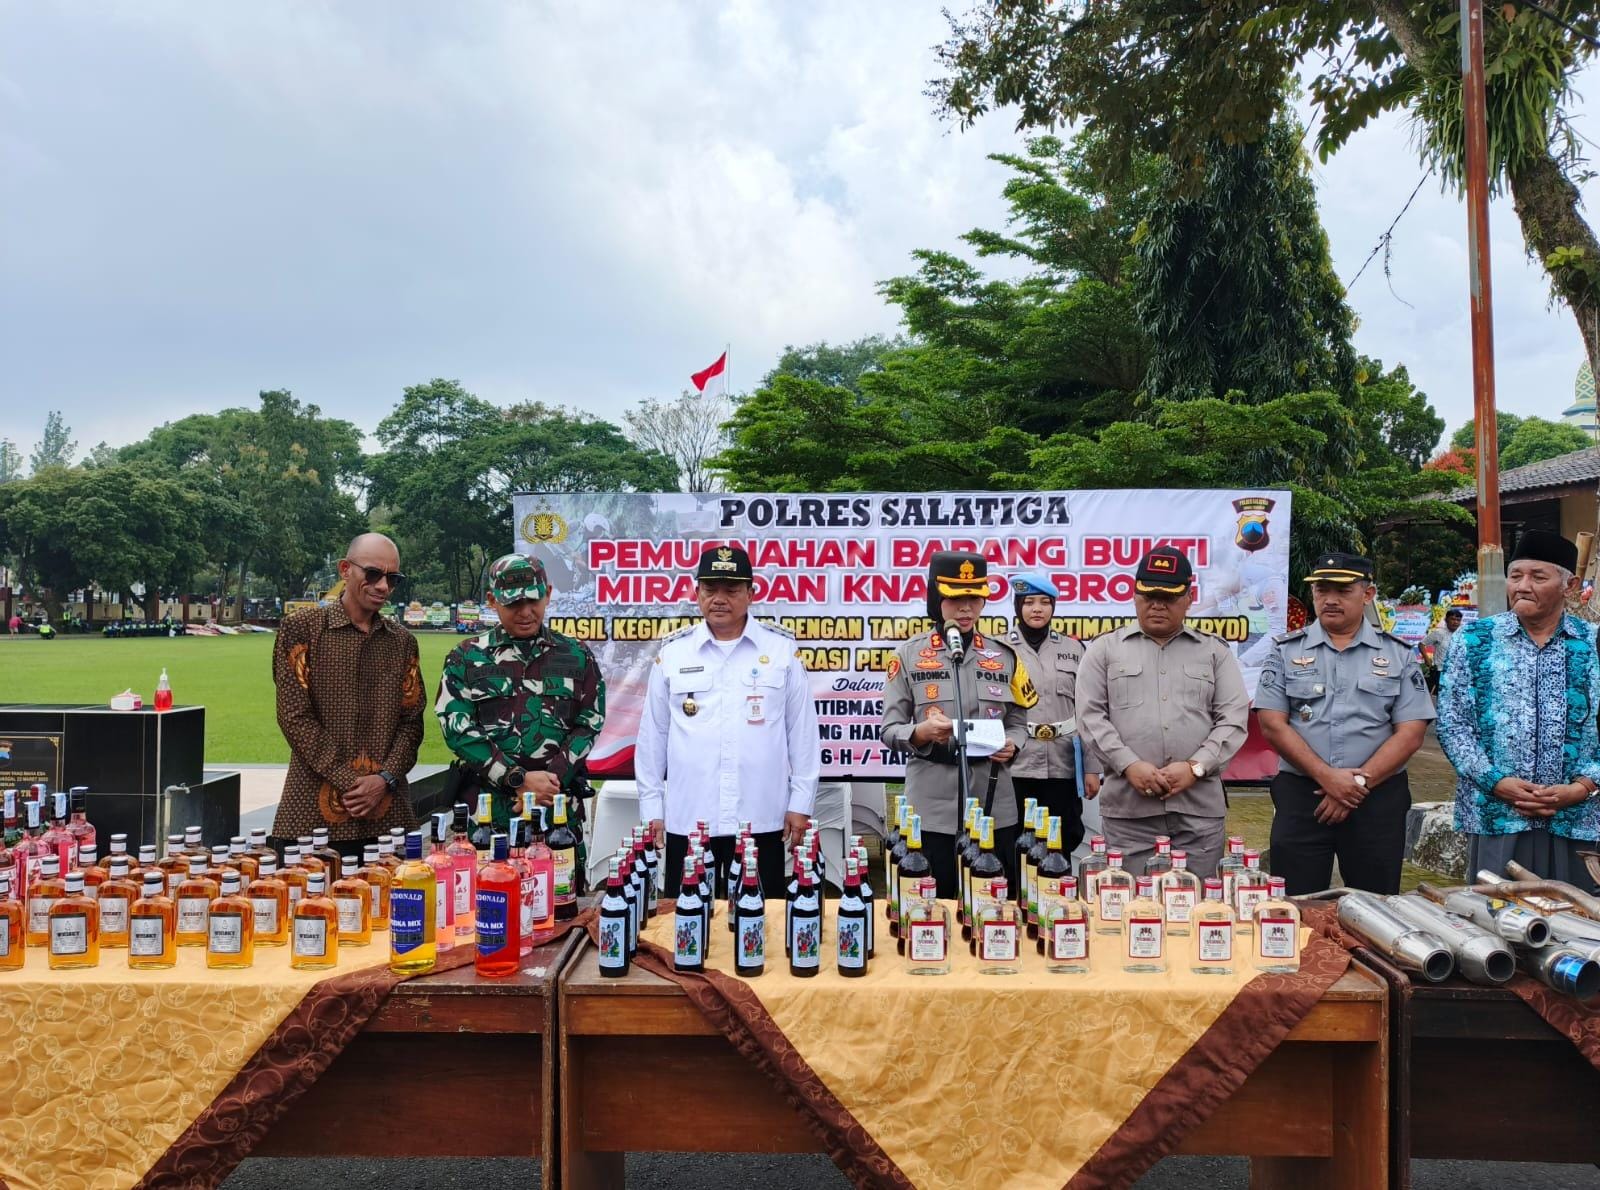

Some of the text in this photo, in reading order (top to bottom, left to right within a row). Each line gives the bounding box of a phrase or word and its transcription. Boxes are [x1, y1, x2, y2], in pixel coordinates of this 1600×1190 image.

[720, 496, 1070, 527] POLRES SALATIGA
[590, 540, 875, 568] PEMUNAHAN
[598, 575, 697, 604] MIRA
[550, 617, 607, 641] HASIL
[869, 616, 937, 640] TARGE
[799, 648, 849, 671] RASI
[832, 678, 884, 691] Dalam
[911, 670, 1009, 684] VERONICA POLRI
[815, 700, 883, 716] TIBMAS
[840, 748, 852, 765] H
[408, 919, 421, 927] MIX
[491, 921, 504, 929] MIX
